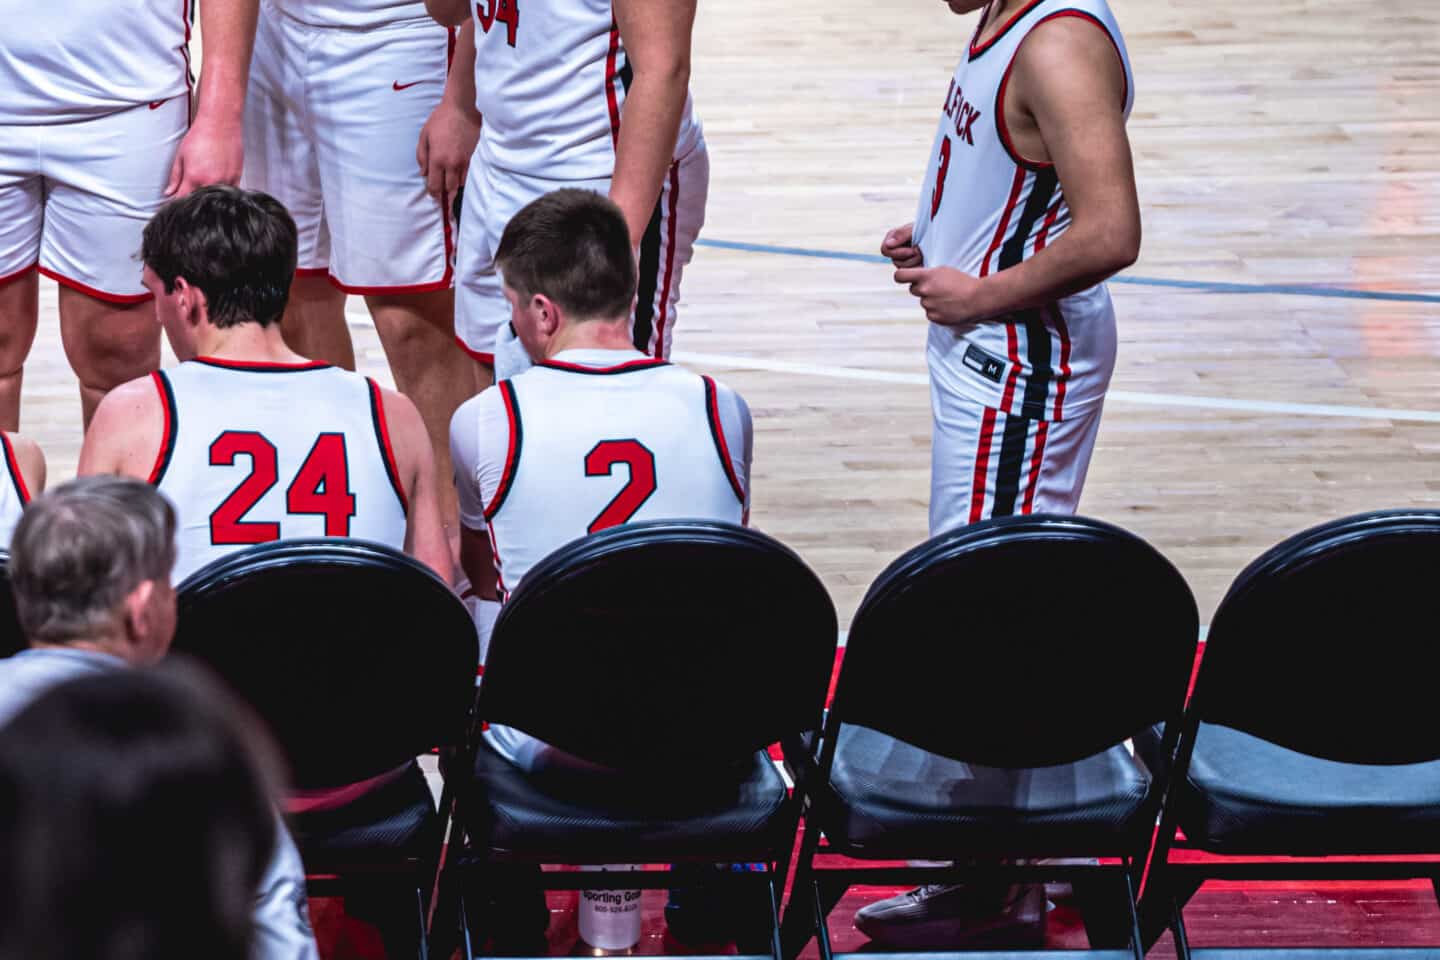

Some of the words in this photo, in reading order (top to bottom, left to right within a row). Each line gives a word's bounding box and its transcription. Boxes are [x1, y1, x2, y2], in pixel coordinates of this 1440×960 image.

[931, 134, 952, 222] 3
[988, 363, 998, 375] M
[209, 430, 356, 546] 24
[584, 438, 656, 534] 2
